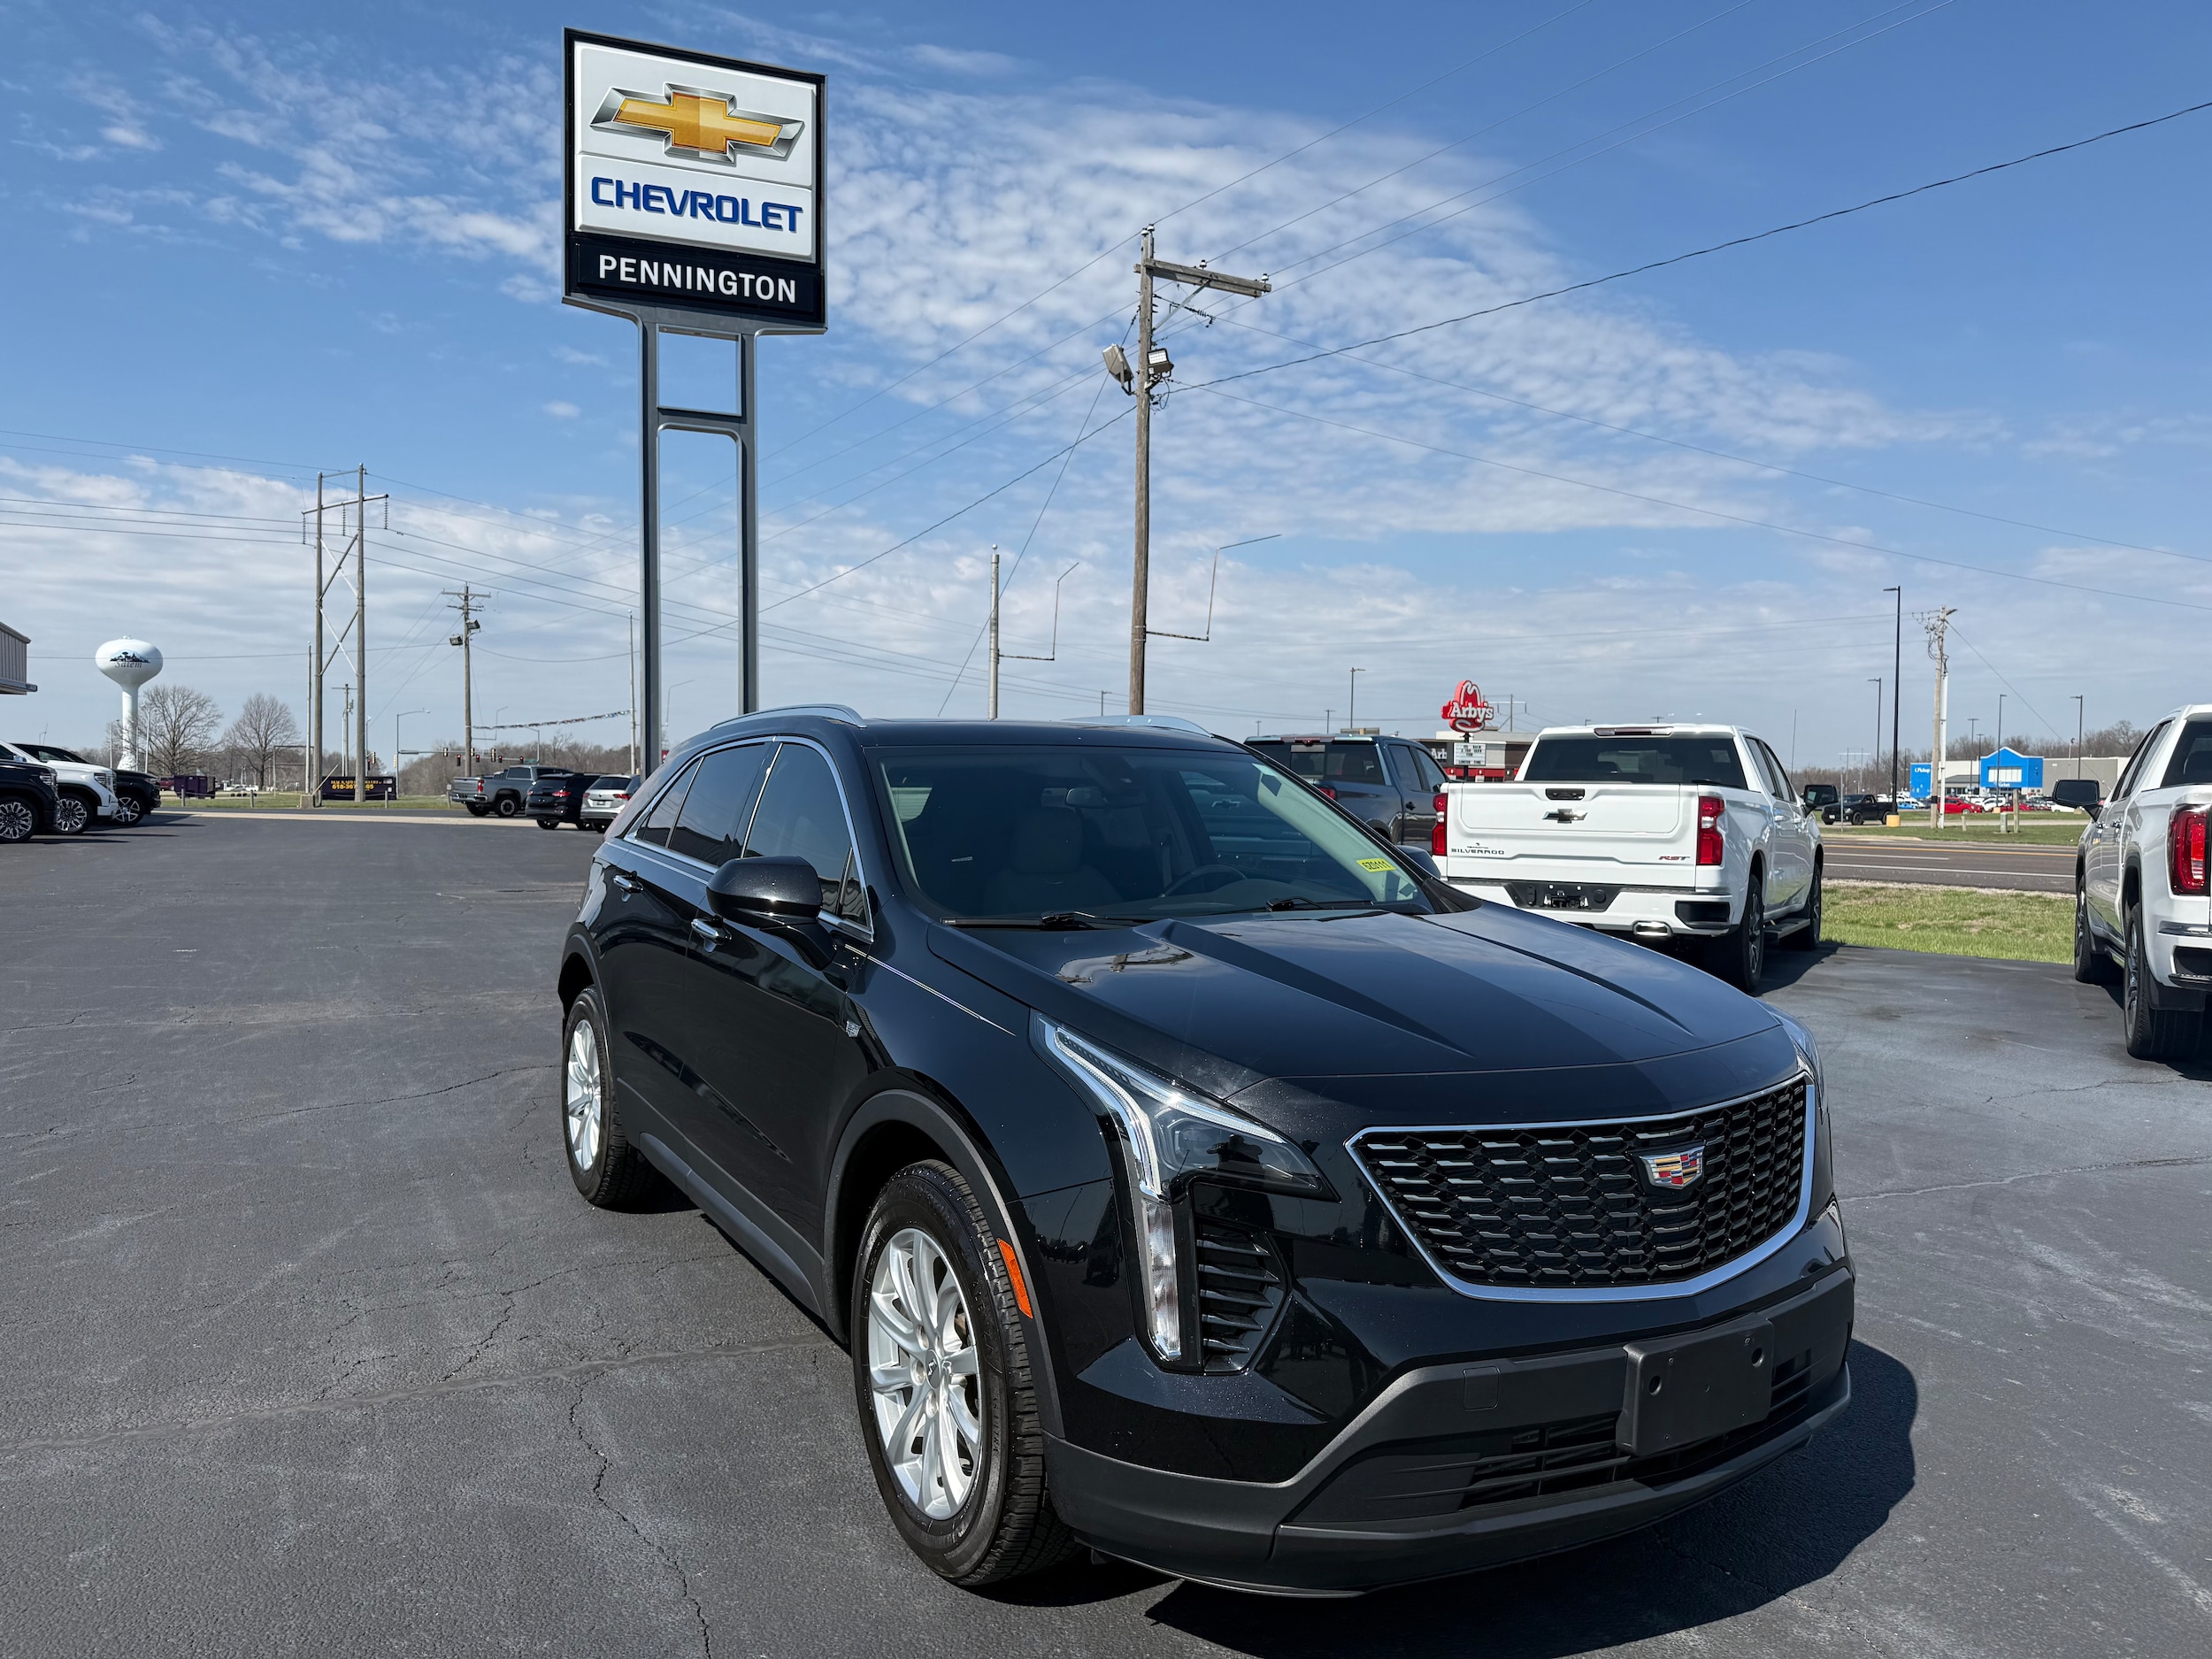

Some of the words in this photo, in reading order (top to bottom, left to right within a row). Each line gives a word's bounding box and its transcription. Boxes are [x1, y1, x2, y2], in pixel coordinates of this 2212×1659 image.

[591, 177, 803, 232] CHEVROLET
[599, 254, 795, 303] PENNINGTON
[1450, 702, 1494, 723] Arby's
